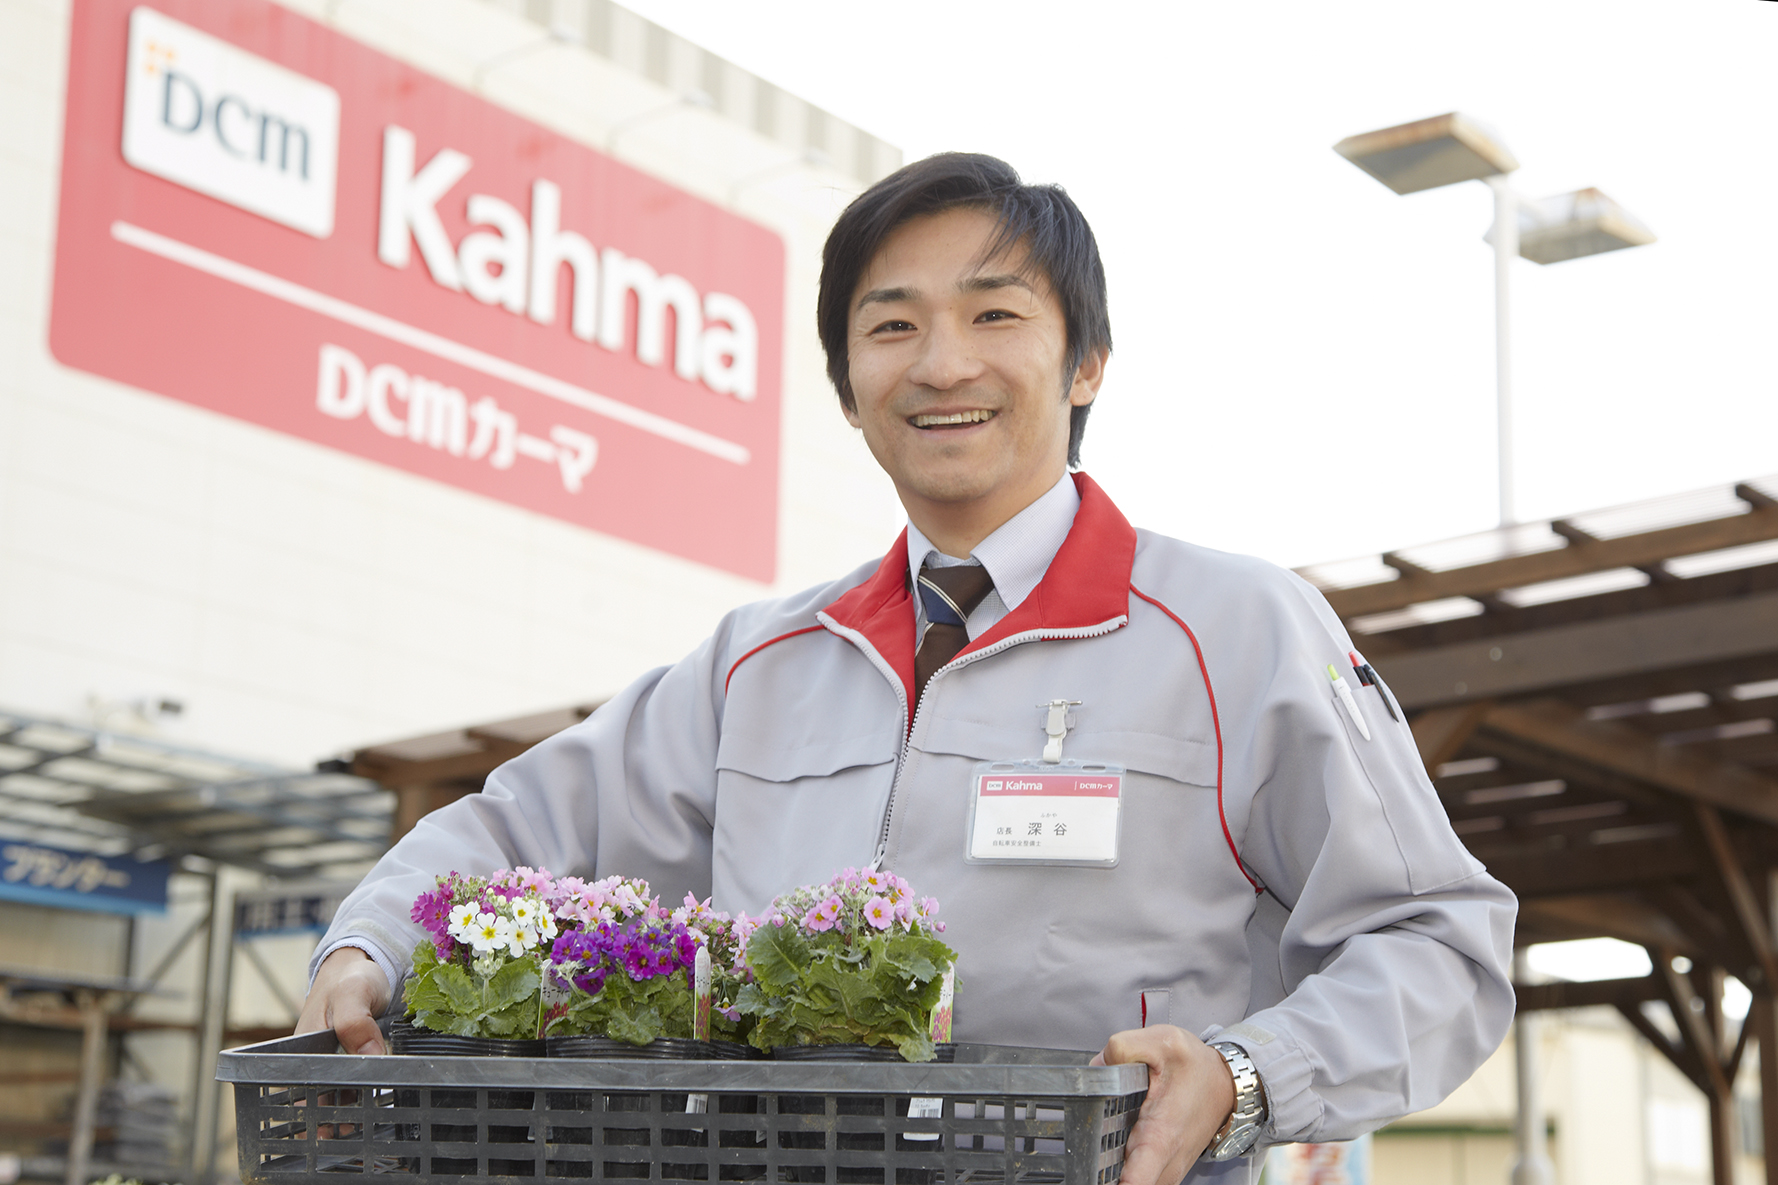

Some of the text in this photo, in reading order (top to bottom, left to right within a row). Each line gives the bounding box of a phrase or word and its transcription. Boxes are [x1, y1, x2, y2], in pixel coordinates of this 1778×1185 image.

[378, 123, 759, 401] Kahma
[1005, 780, 1043, 791] Kahma
[996, 822, 1068, 836] 店長 深谷
